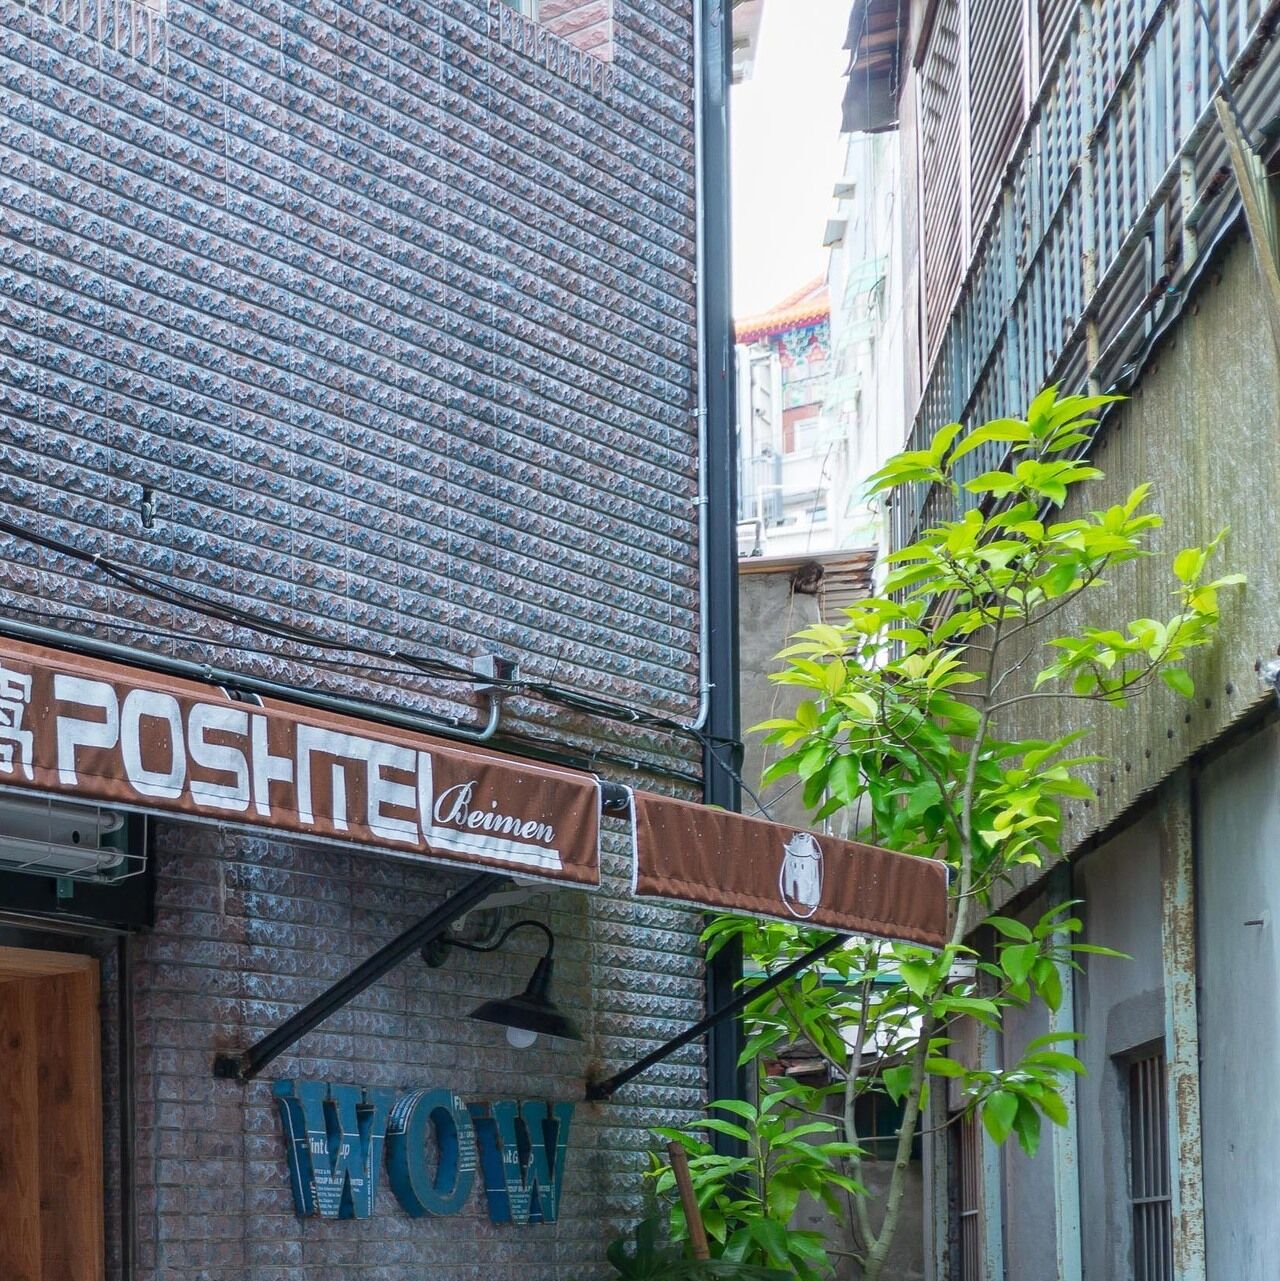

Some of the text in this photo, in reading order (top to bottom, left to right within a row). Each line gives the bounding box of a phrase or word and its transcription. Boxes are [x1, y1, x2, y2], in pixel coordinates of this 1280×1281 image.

[51, 672, 563, 871] POSHTEL Beimen
[272, 1080, 576, 1224] WOW
